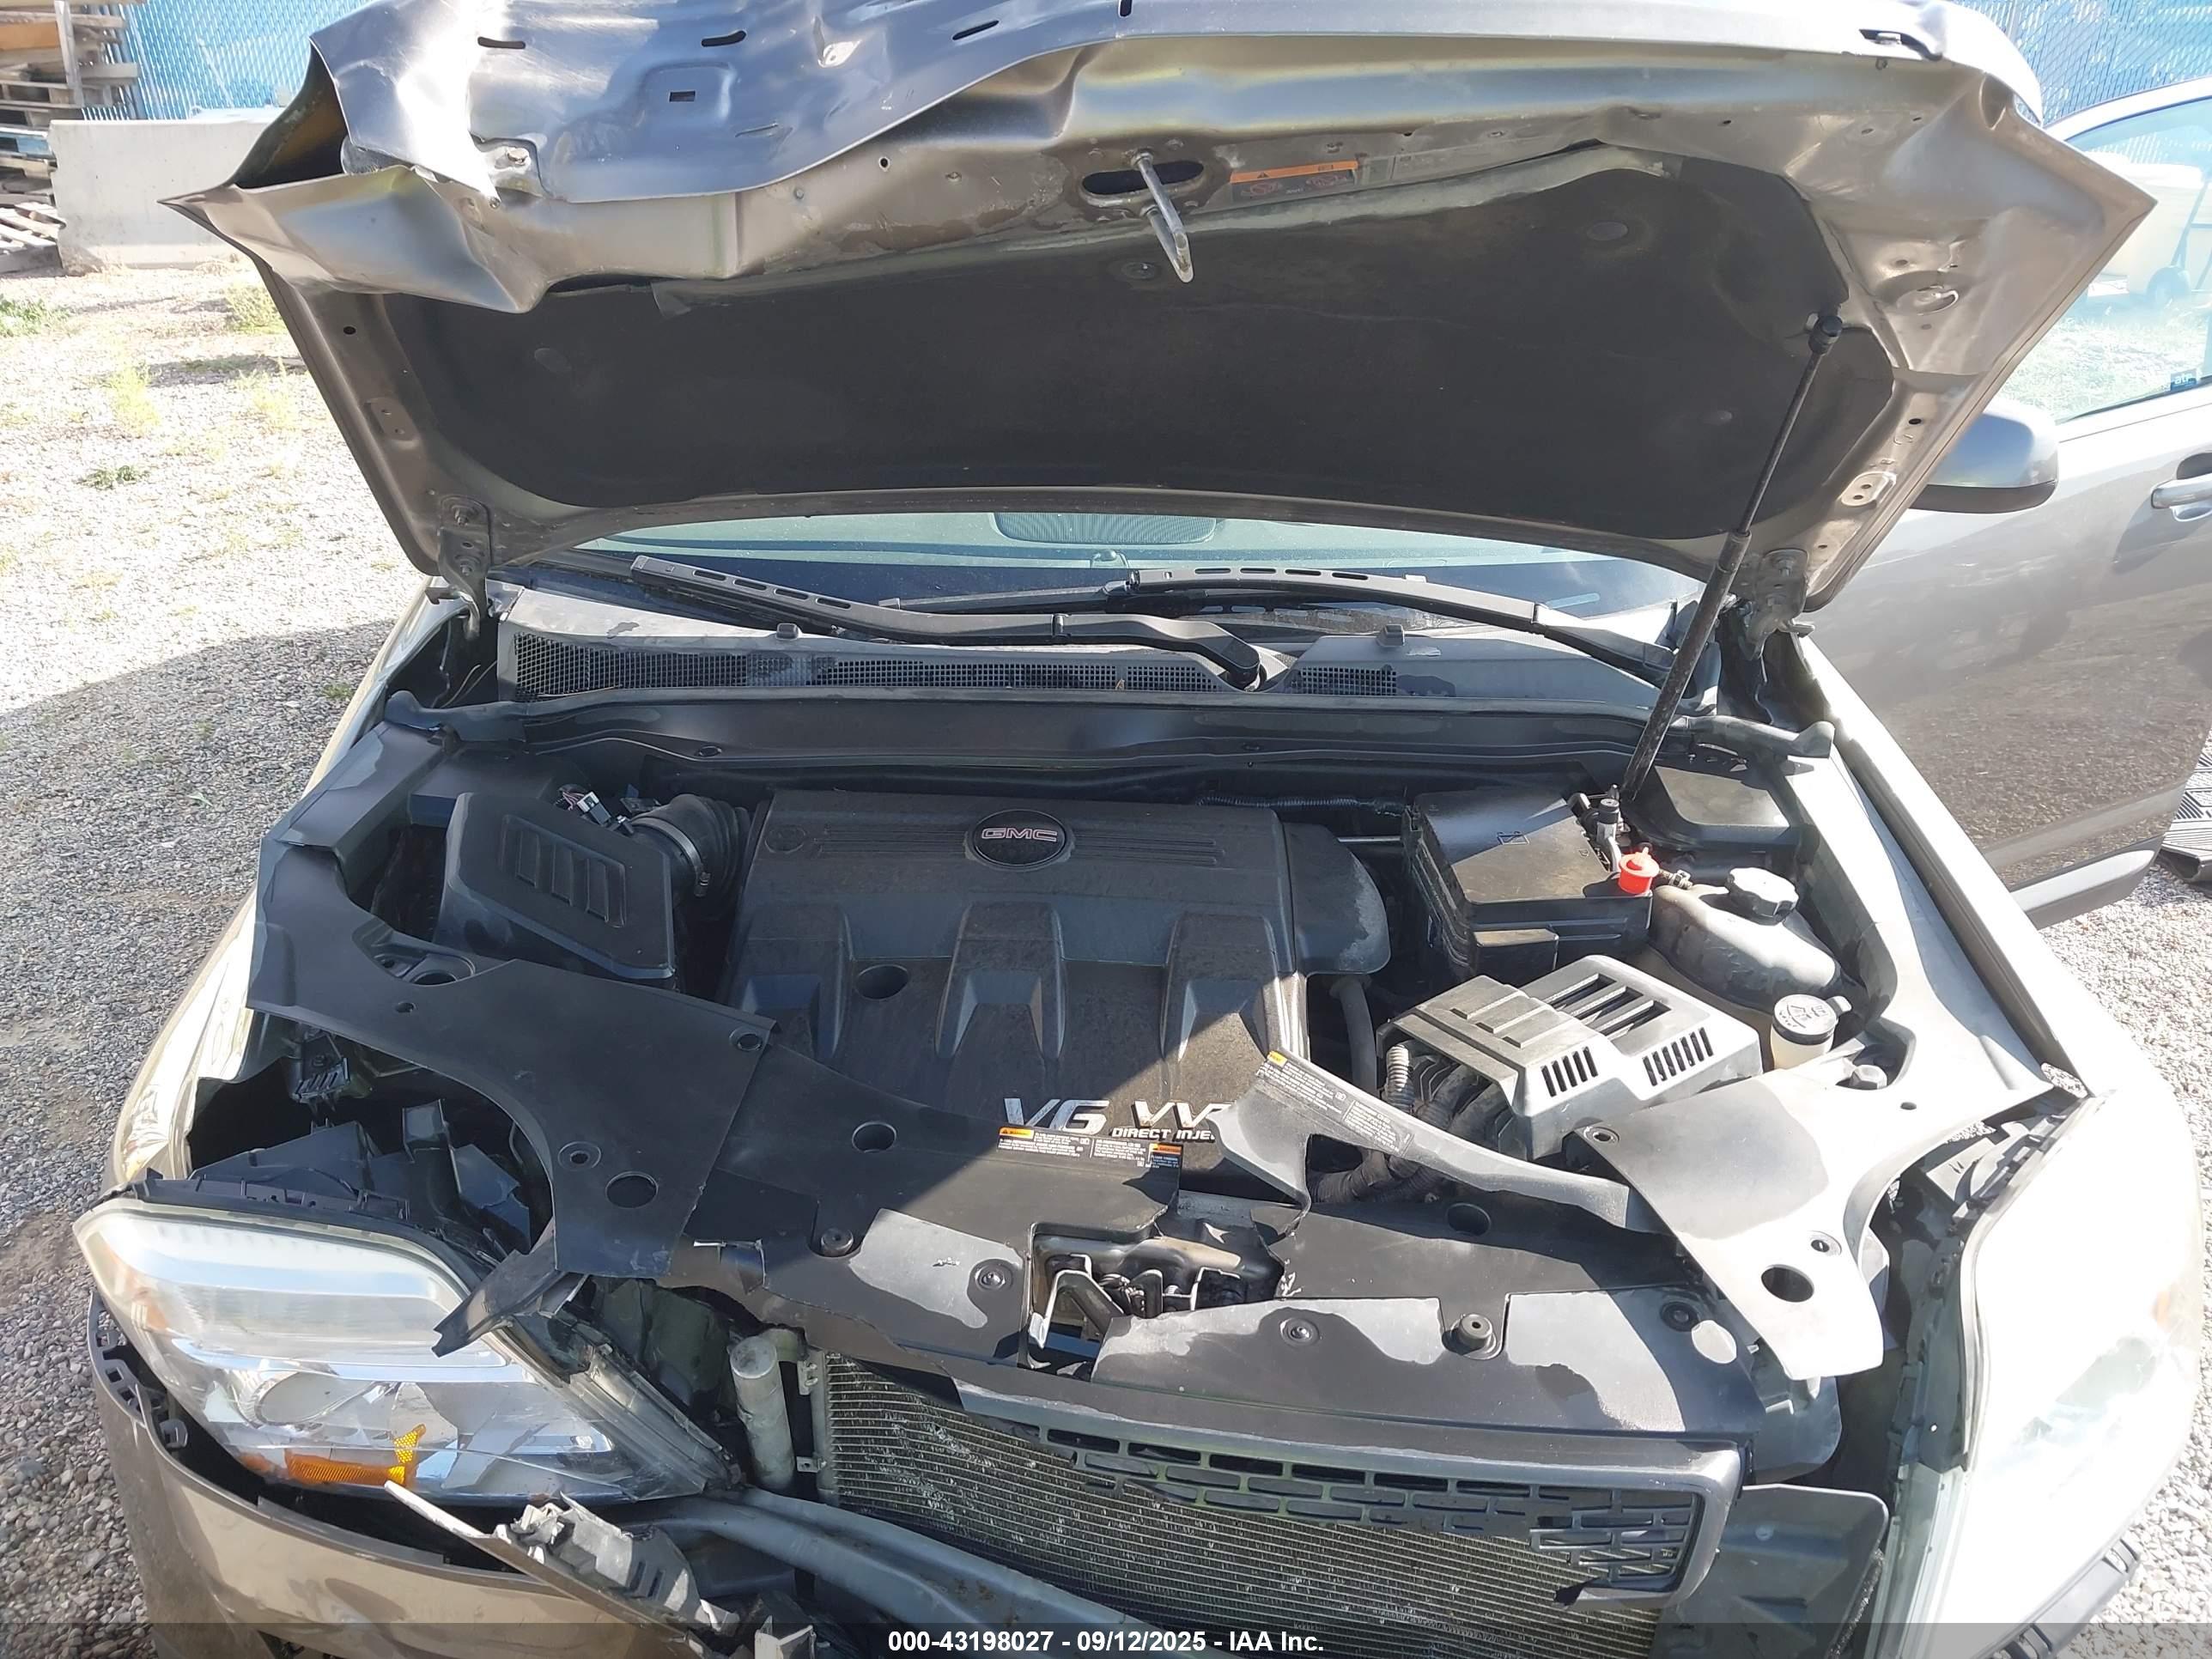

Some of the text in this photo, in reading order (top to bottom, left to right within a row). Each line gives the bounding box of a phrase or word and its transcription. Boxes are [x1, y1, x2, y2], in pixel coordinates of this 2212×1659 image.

[981, 827, 1058, 842] GMC
[1004, 1097, 1110, 1135] V6
[1111, 1127, 1216, 1141] DIRECT INJE
